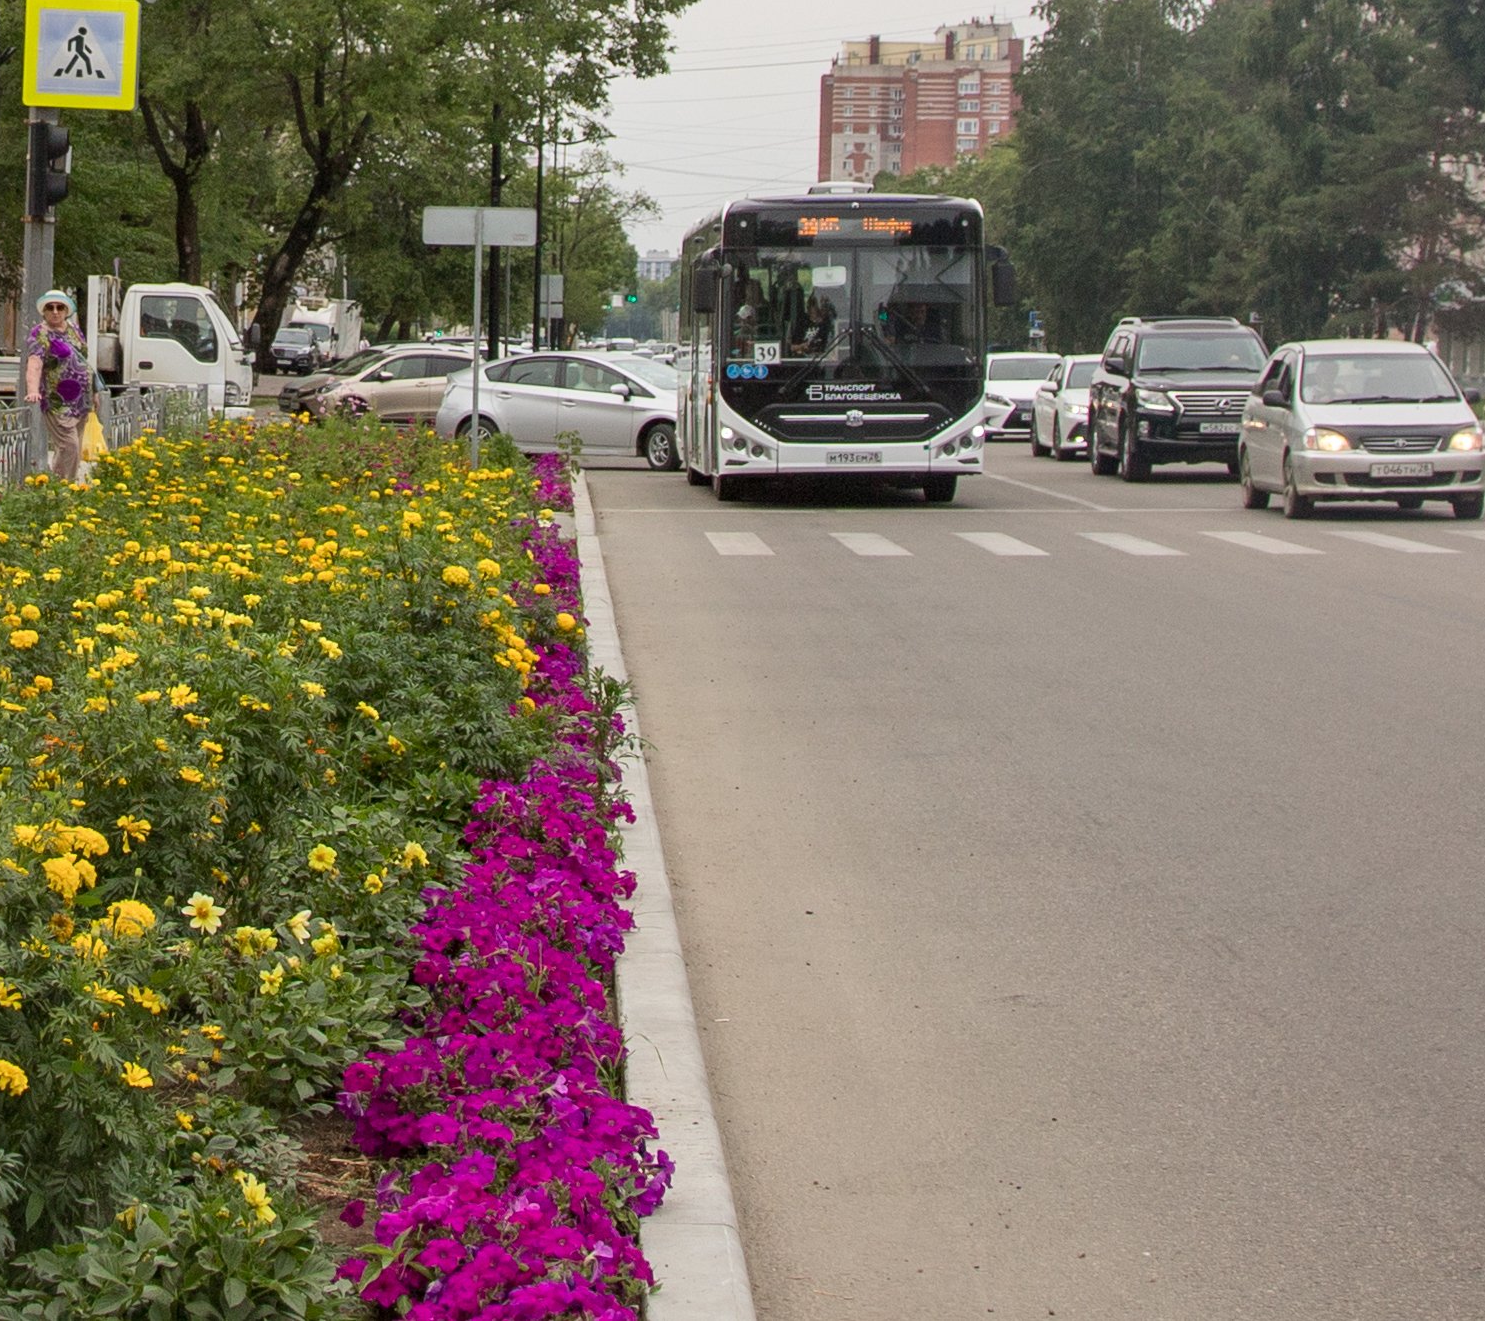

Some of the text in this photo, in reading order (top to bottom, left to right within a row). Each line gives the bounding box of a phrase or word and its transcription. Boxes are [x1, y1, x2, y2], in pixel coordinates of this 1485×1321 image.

[755, 346, 777, 362] 39
[824, 384, 876, 392] ТРАНСПОРТ
[824, 392, 901, 401] БЛАГОВЕЩЕНСКА
